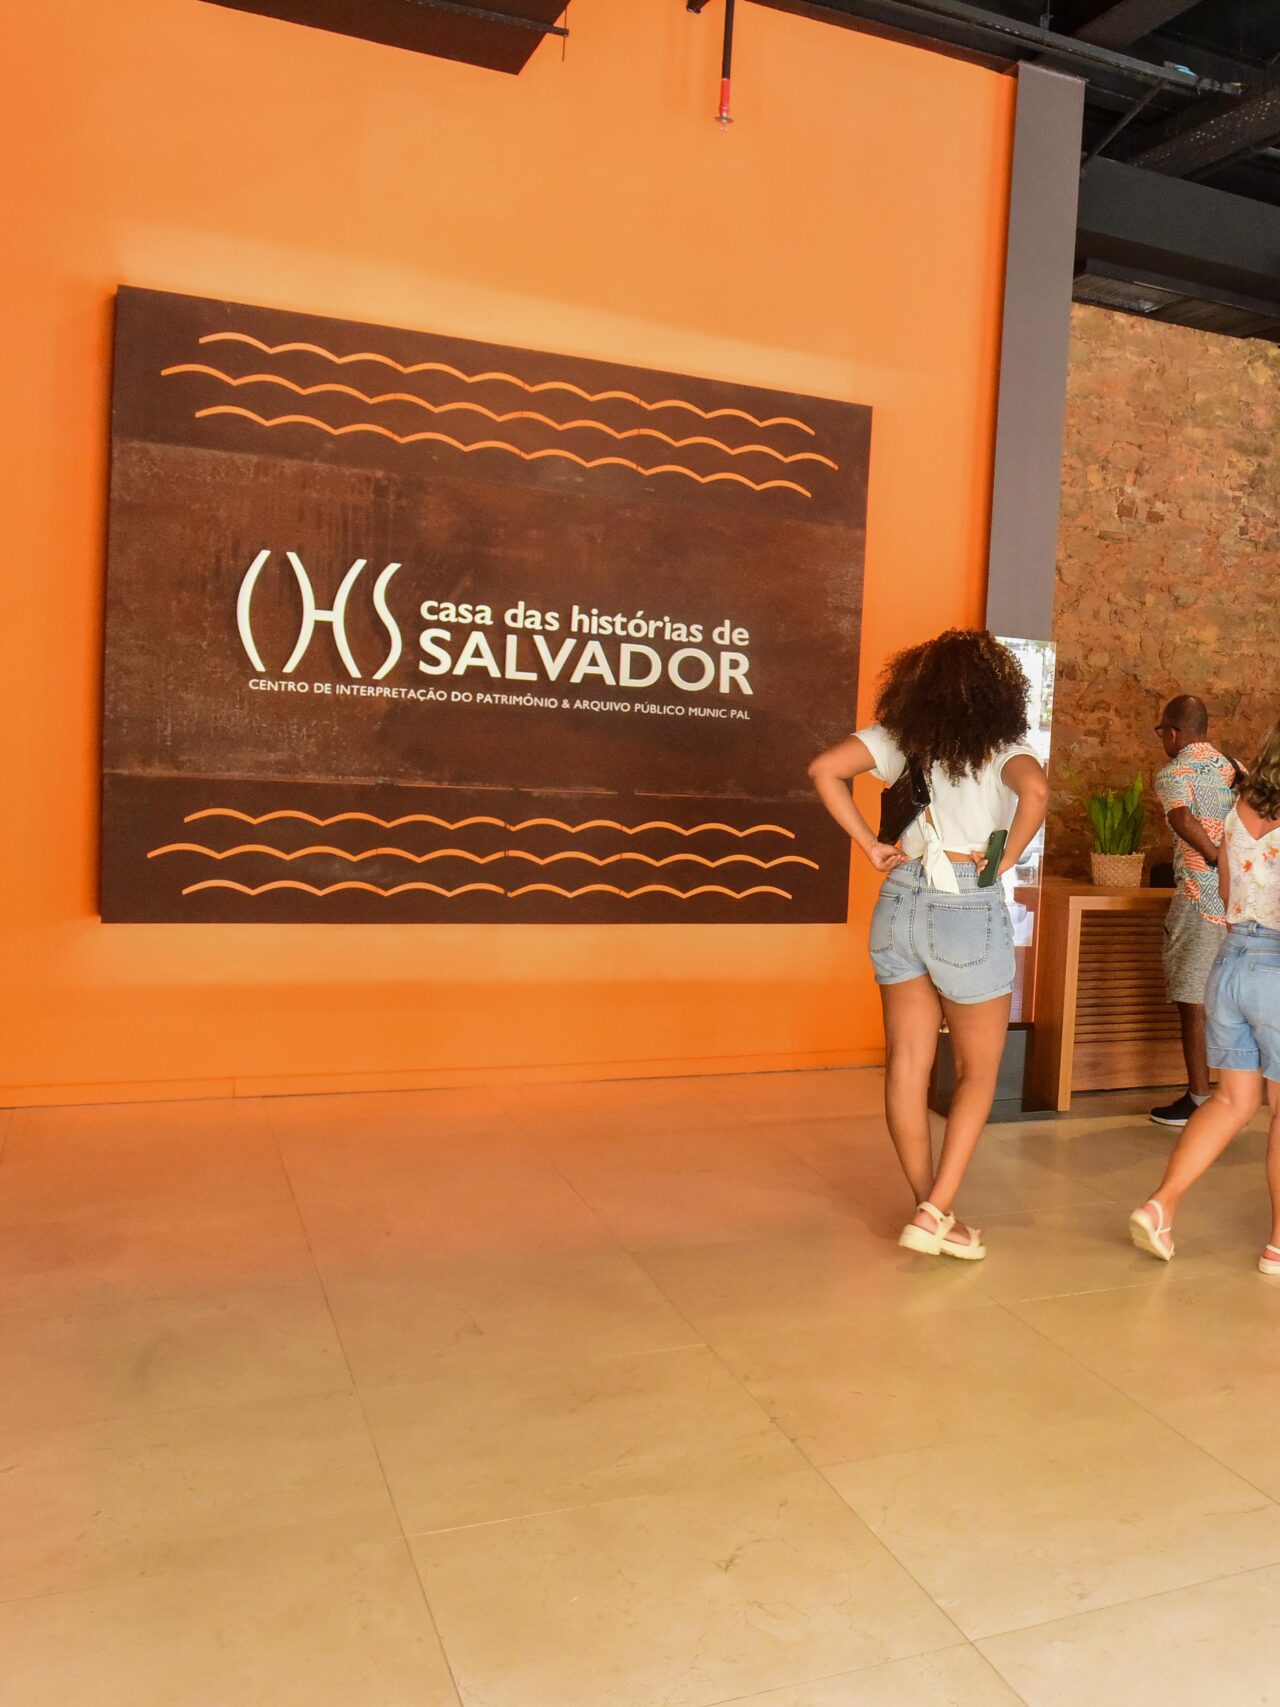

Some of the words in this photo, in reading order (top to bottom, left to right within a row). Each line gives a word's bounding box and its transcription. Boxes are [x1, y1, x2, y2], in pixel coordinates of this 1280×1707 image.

[420, 600, 493, 625] casa
[504, 600, 560, 631] das
[571, 604, 703, 643] histórias
[712, 619, 750, 646] de
[418, 627, 754, 695] SALVADOR
[248, 678, 309, 694] CENTRO
[313, 683, 332, 695] DE
[335, 684, 448, 702] INTERPRETAÇÃO
[450, 691, 473, 703] DO
[476, 693, 559, 709] PATRIMÔNIO
[561, 698, 571, 709] &
[573, 699, 631, 713] ARQUIVO
[634, 701, 686, 716] PÚBLICO
